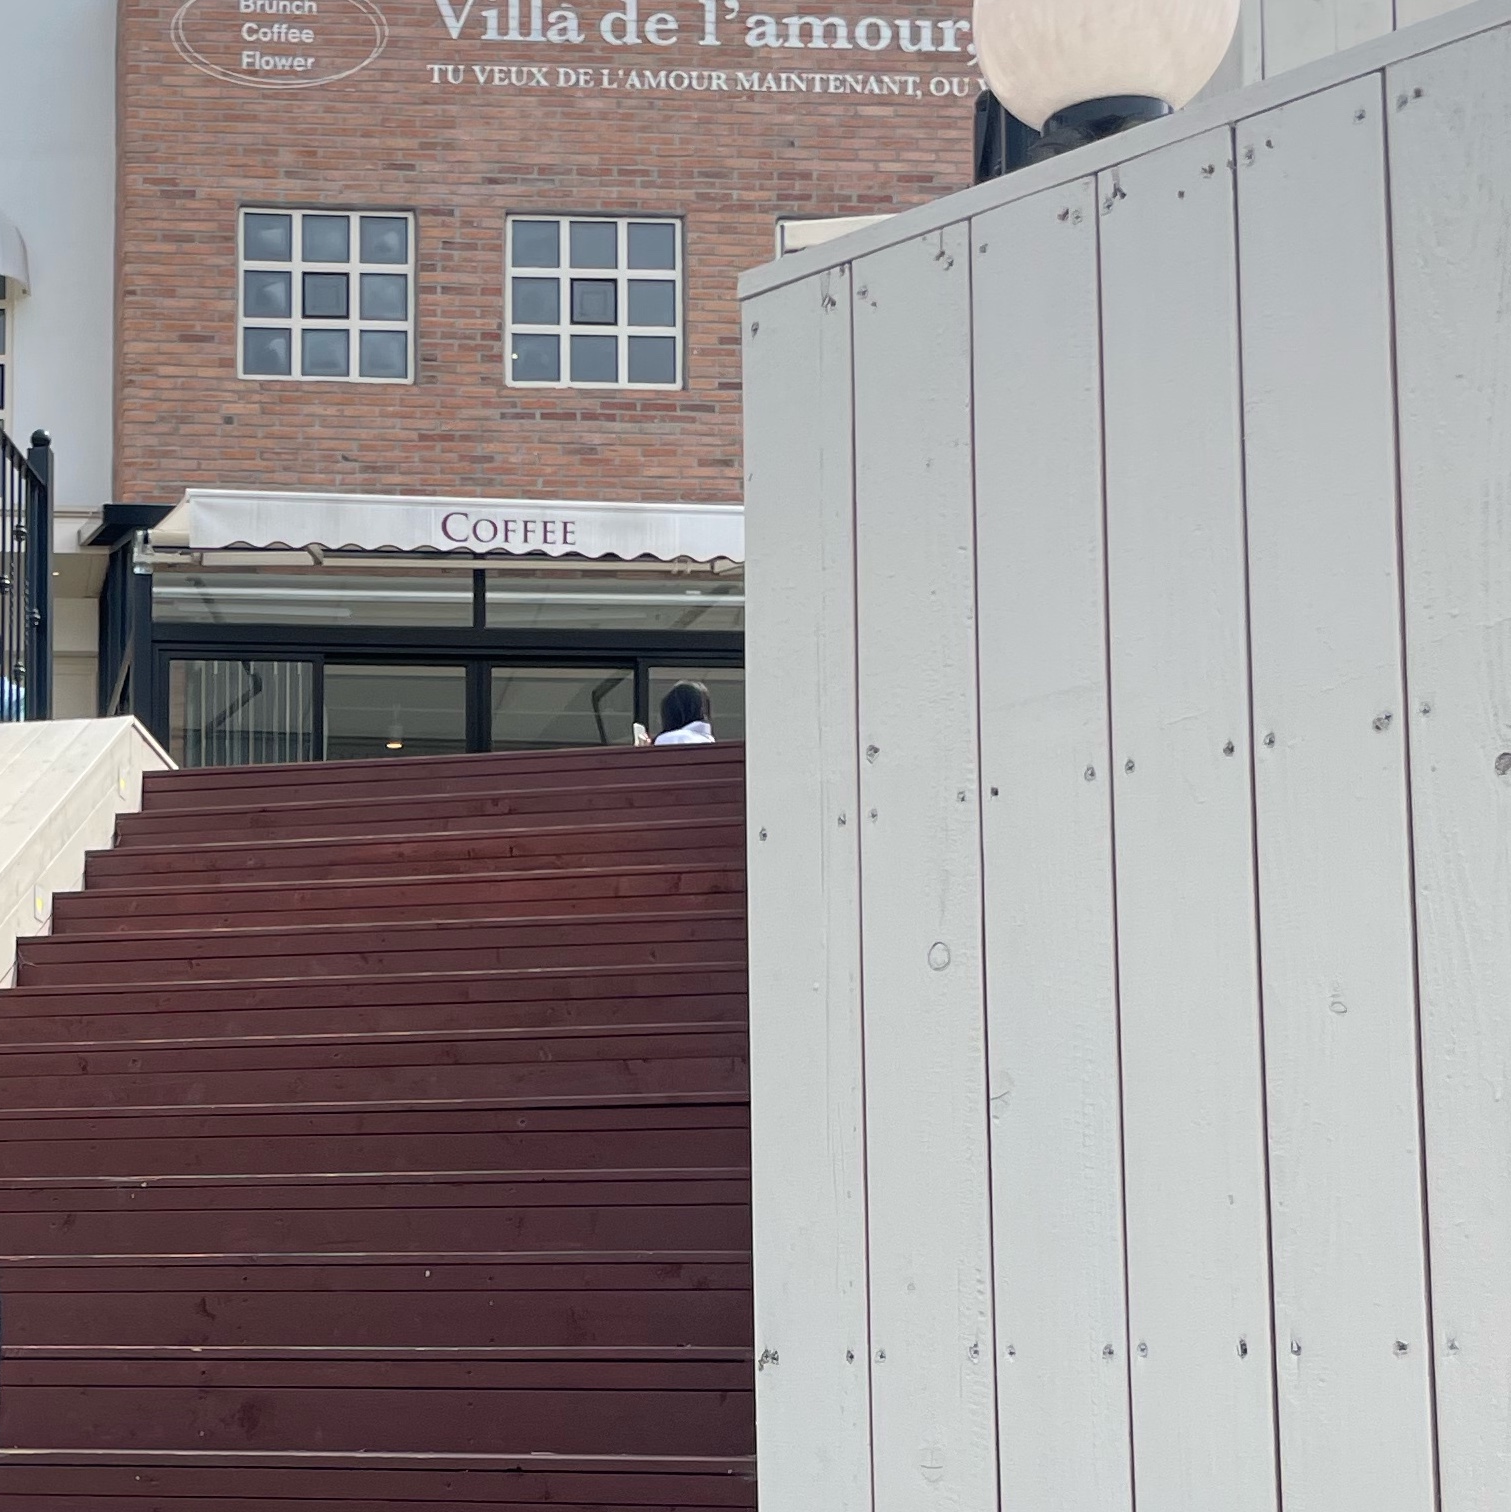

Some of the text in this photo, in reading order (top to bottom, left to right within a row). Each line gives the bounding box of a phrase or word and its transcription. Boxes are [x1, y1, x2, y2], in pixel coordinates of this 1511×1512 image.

[239, 0, 318, 15] Brunch
[241, 22, 315, 43] Coffee
[600, 0, 679, 45] de
[241, 51, 316, 71] Flower
[426, 64, 465, 85] TU
[472, 65, 550, 87] VEUX
[556, 67, 595, 88] DE
[600, 69, 729, 91] L'AMOUR
[734, 71, 923, 99] MAINTENANT,
[929, 76, 970, 97] OU
[441, 511, 577, 546] COFFEE
